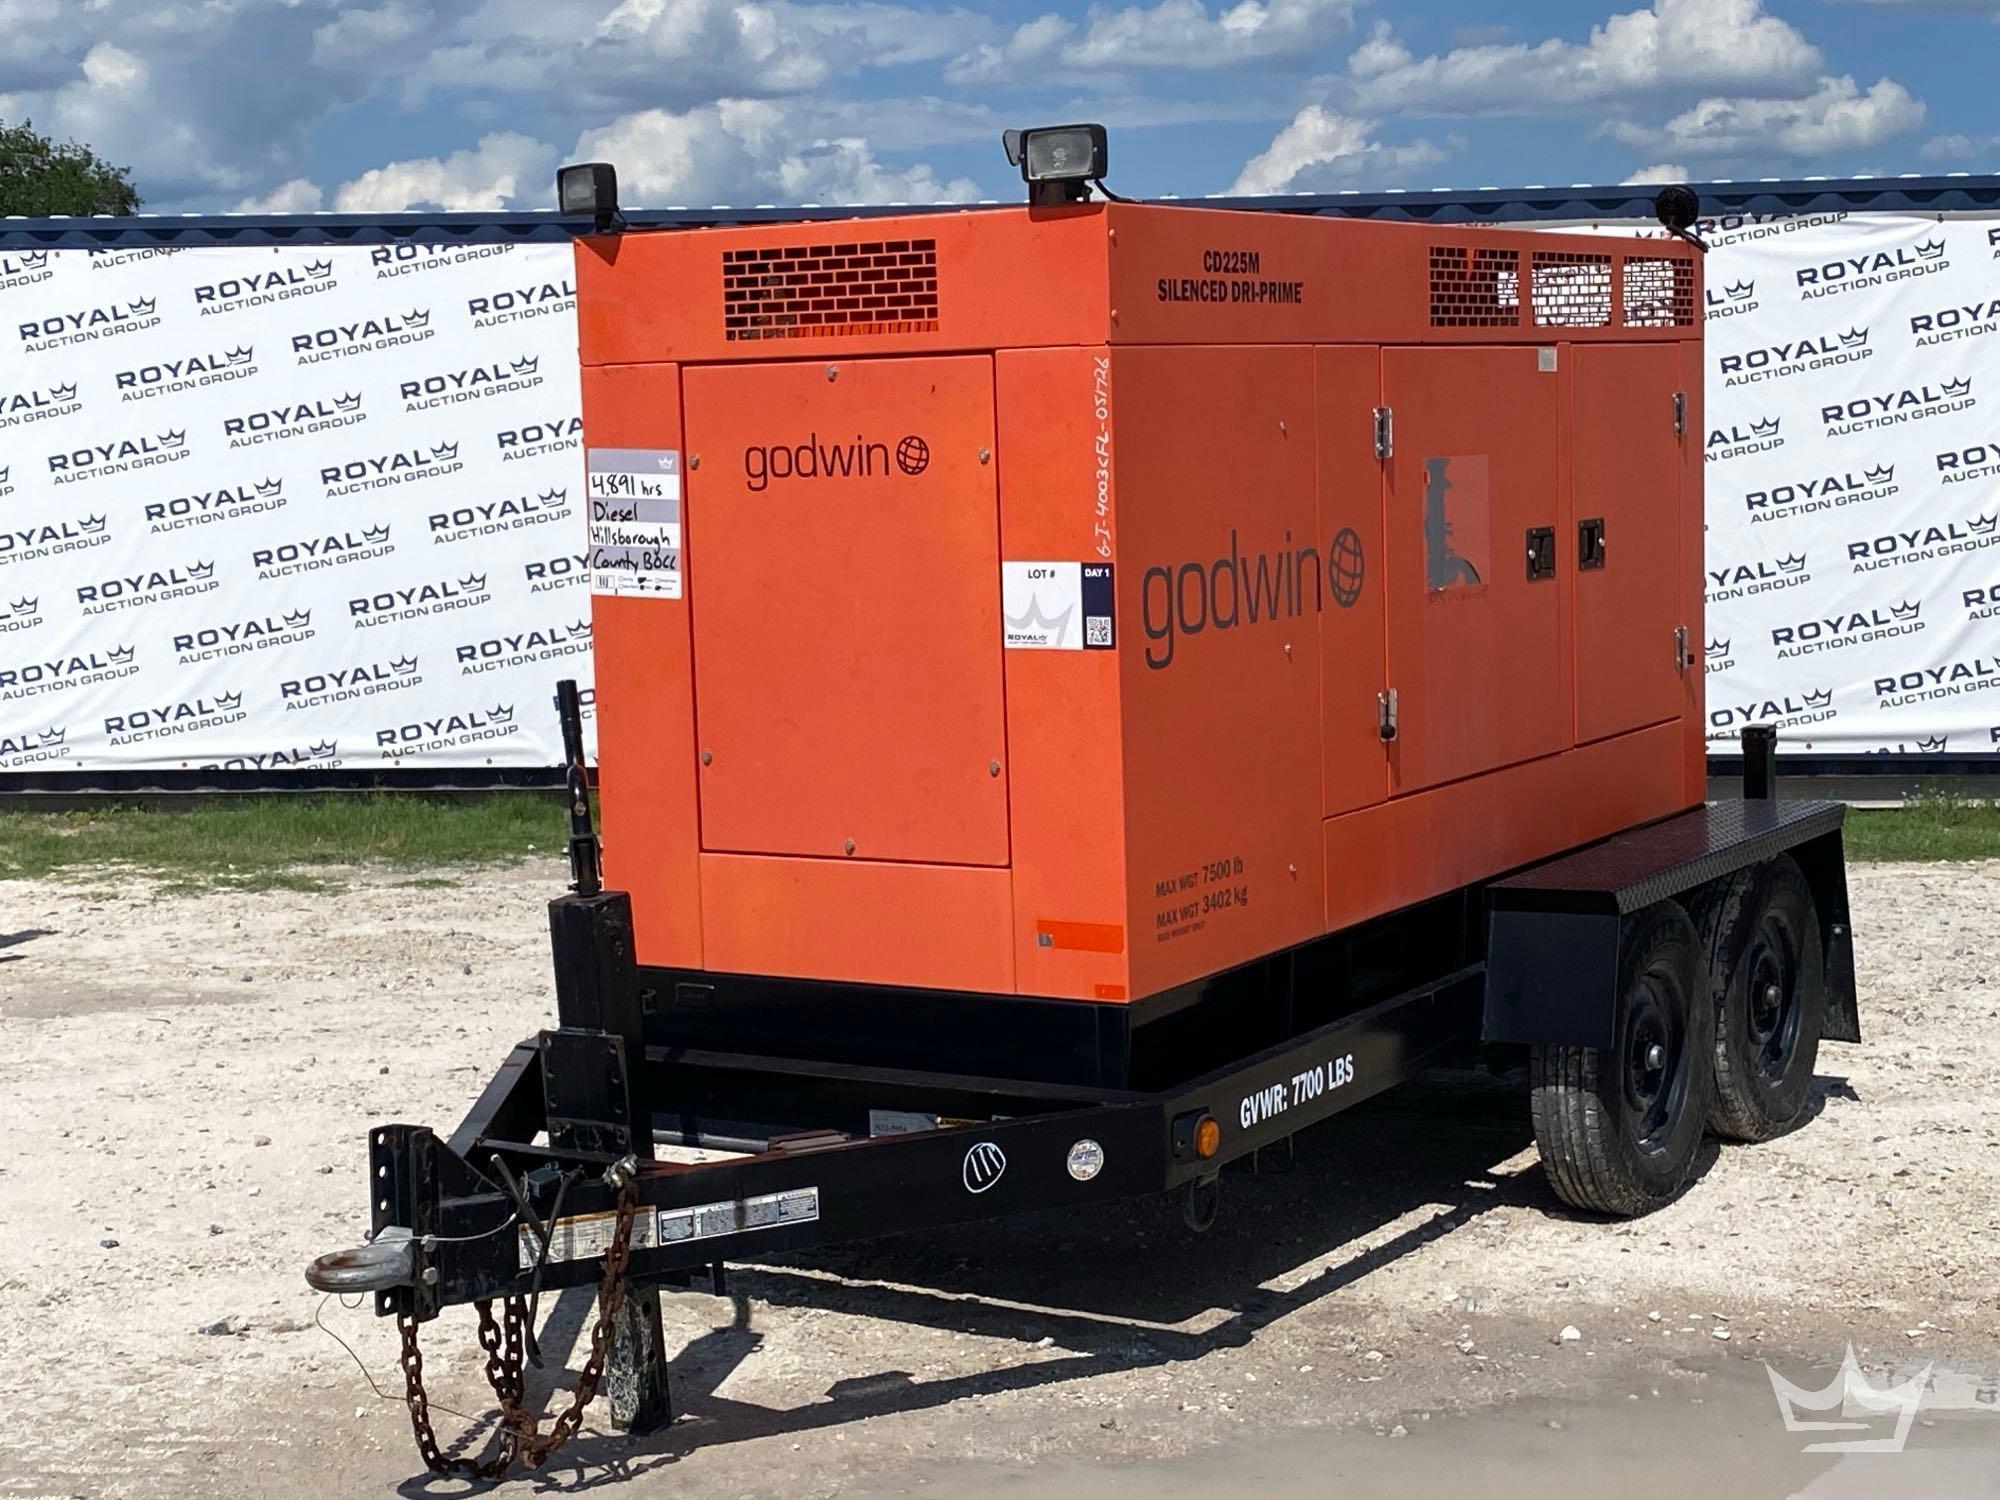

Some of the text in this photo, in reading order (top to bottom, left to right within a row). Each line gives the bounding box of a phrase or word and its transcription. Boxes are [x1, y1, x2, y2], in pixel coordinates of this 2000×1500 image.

[1784, 211, 1848, 233] GROUP
[92, 248, 165, 270] AUCTION
[376, 244, 515, 279] AUCTION GROUP
[1204, 250, 1260, 273] CD225M
[1797, 249, 1916, 287] ROYAL
[194, 268, 305, 303] ROYAL
[200, 280, 337, 317] AUCTION GROUP
[468, 280, 577, 315] ROYAL
[1158, 279, 1303, 303] SILENCED DRI-PRIME
[1801, 261, 1950, 301] AUCTION GROUP
[19, 305, 129, 340] ROYAL
[24, 317, 161, 353] AUCTION GROUP
[292, 317, 402, 352] ROYAL
[474, 307, 549, 329] AUCTION
[1915, 322, 1997, 348] AUCTION
[297, 329, 434, 365] AUCTION GROUP
[1720, 336, 1839, 374] ROYAL
[115, 354, 227, 389] ROYAL
[121, 366, 258, 402] AUCTION GROUP
[400, 364, 511, 399] ROYAL
[1725, 349, 1873, 388] AUCTION GROUP
[406, 377, 543, 413] AUCTION GROUP
[1821, 386, 1941, 424] ROYAL
[23, 403, 82, 423] GROUP
[224, 401, 334, 436] ROYAL
[1826, 398, 1976, 438] AUCTION GROUP
[229, 413, 366, 449] AUCTION GROUP
[497, 417, 583, 448] ROYA
[1720, 438, 1785, 459] GROUP
[48, 437, 158, 472] ROYAL
[53, 449, 191, 485] AUCTION GROUP
[502, 438, 578, 461] AUCTION
[745, 432, 889, 491] godwin
[320, 450, 431, 485] ROYAL
[326, 462, 463, 498] AUCTION GROUP
[592, 473, 662, 497] 4,891 hrs
[145, 486, 255, 521] ROYAL
[1746, 472, 1865, 510] ROYAL
[1750, 486, 1899, 524] AUCTION GROUP
[150, 498, 287, 535] AUCTION GROUP
[429, 497, 539, 532] ROYAL
[434, 509, 572, 545] AUCTION GROUP
[593, 501, 638, 522] Diesel
[0, 522, 79, 551] OYAL
[0, 535, 111, 565] CTION GROUP
[253, 532, 363, 567] ROYAL
[591, 526, 670, 555] Hillsborough
[1847, 523, 1967, 560] ROYAL
[258, 545, 395, 581] AUCTION GROUP
[525, 553, 590, 580] ROY
[593, 549, 638, 575] County
[1852, 535, 2000, 574] AUCTION GROUP
[77, 568, 187, 604] ROYAL
[531, 574, 591, 593] AUCTIO
[1028, 569, 1047, 579] LOT
[1084, 568, 1110, 577] DAY 1
[1709, 561, 1777, 587] YAL
[1747, 574, 1811, 595] GROUP
[82, 580, 220, 617] AUCTION GROUP
[349, 582, 459, 616] ROYAL
[354, 594, 491, 629] AUCTION GROUP
[1143, 529, 1322, 670] godwin
[173, 617, 284, 652] ROYAL
[456, 627, 567, 663] ROYAL
[1772, 609, 1891, 646] ROYAL
[1777, 622, 1925, 660] AUCTION GROUP
[178, 629, 316, 665] AUCTION GROUP
[0, 653, 108, 688] ROYAL
[280, 664, 390, 698] ROYAL
[461, 653, 537, 677] AUCTION
[1874, 659, 1994, 696] ROYAL
[2, 665, 140, 701] AUCTION GROUP
[285, 676, 423, 712] AUCTION GROUP
[1879, 685, 1960, 710] AUCTION
[104, 699, 215, 734] ROYAL
[109, 711, 247, 747] AUCTION GROUP
[376, 712, 487, 747] ROYAL
[1710, 697, 1803, 728] OYAL
[12, 748, 70, 768] GROUP
[381, 725, 519, 760] AUCTION GROUP
[1156, 880, 1177, 898] MAX
[1179, 872, 1198, 891] WGT
[1202, 859, 1230, 883] 7500
[1157, 885, 1248, 928] MAX WGT 3402 kg
[1240, 1054, 1353, 1129] GVWR: 7700 LBS
